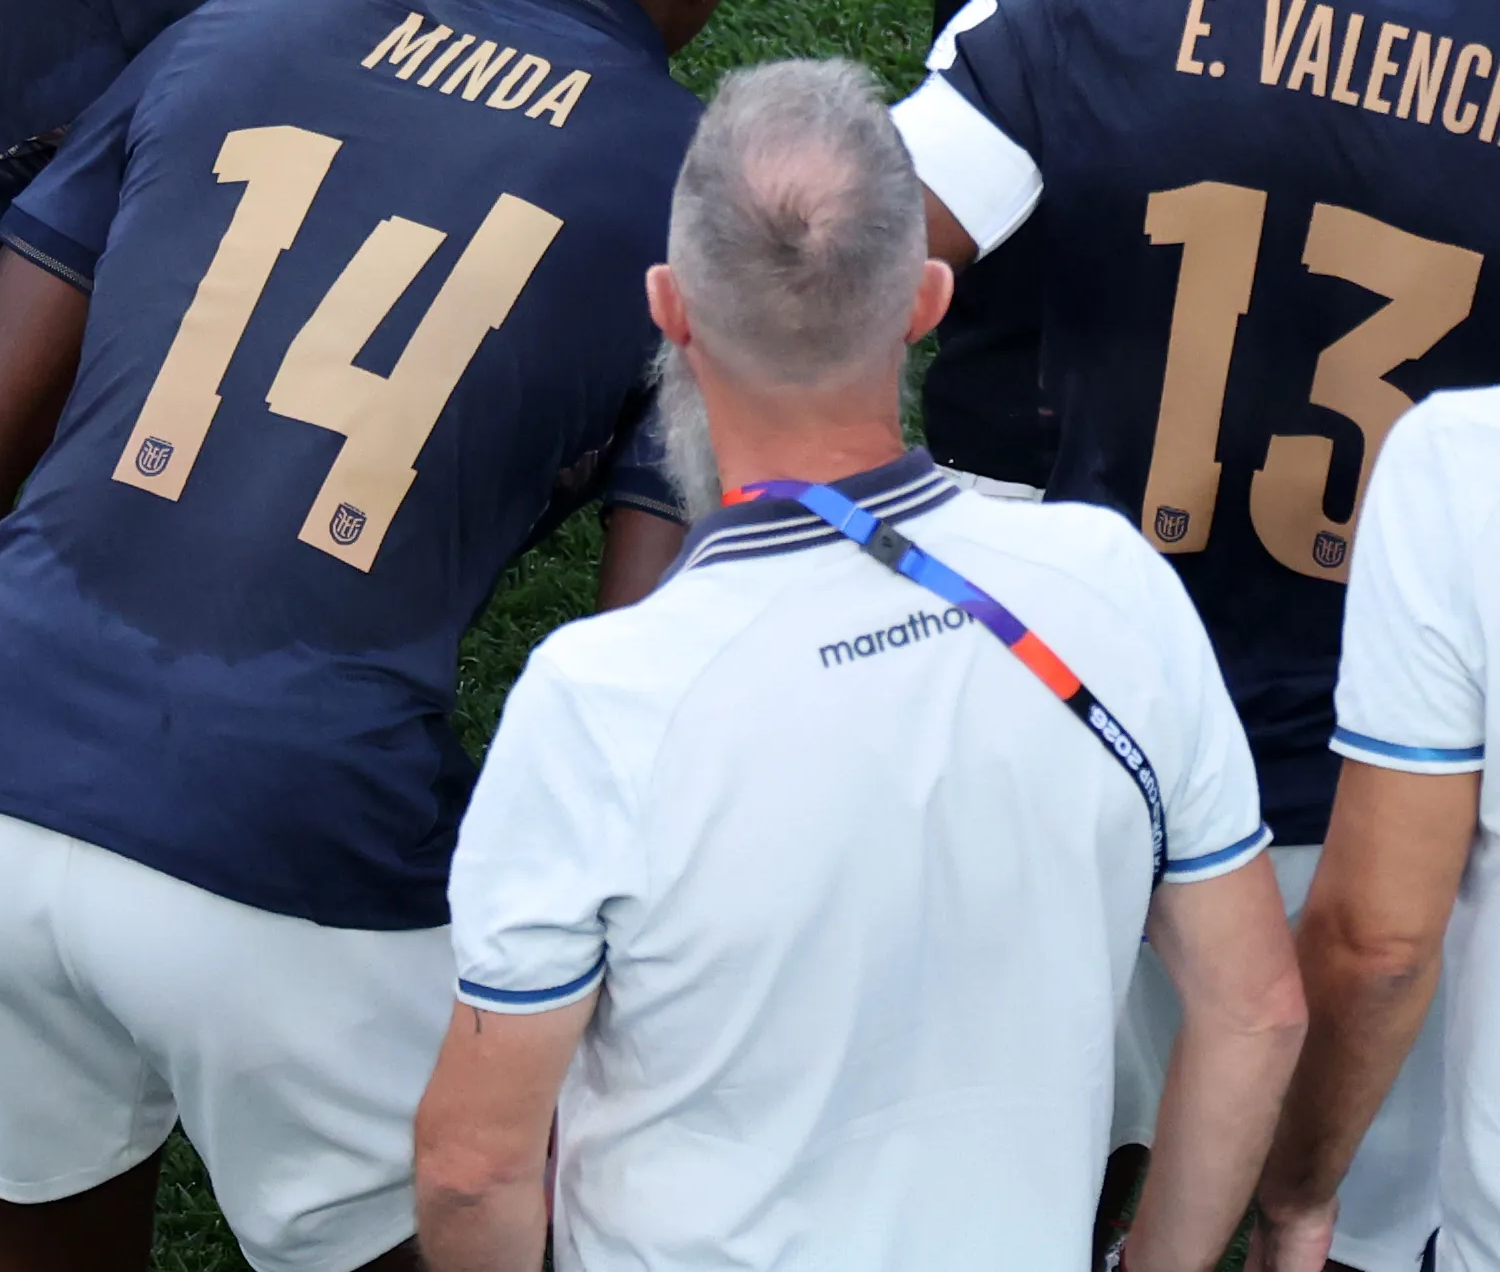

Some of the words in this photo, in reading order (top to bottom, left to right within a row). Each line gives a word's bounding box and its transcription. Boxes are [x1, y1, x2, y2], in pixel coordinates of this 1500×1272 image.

[360, 12, 593, 129] MINDA
[111, 124, 565, 573] 14
[1142, 180, 1486, 586] 13
[1089, 704, 1144, 772] 2026
